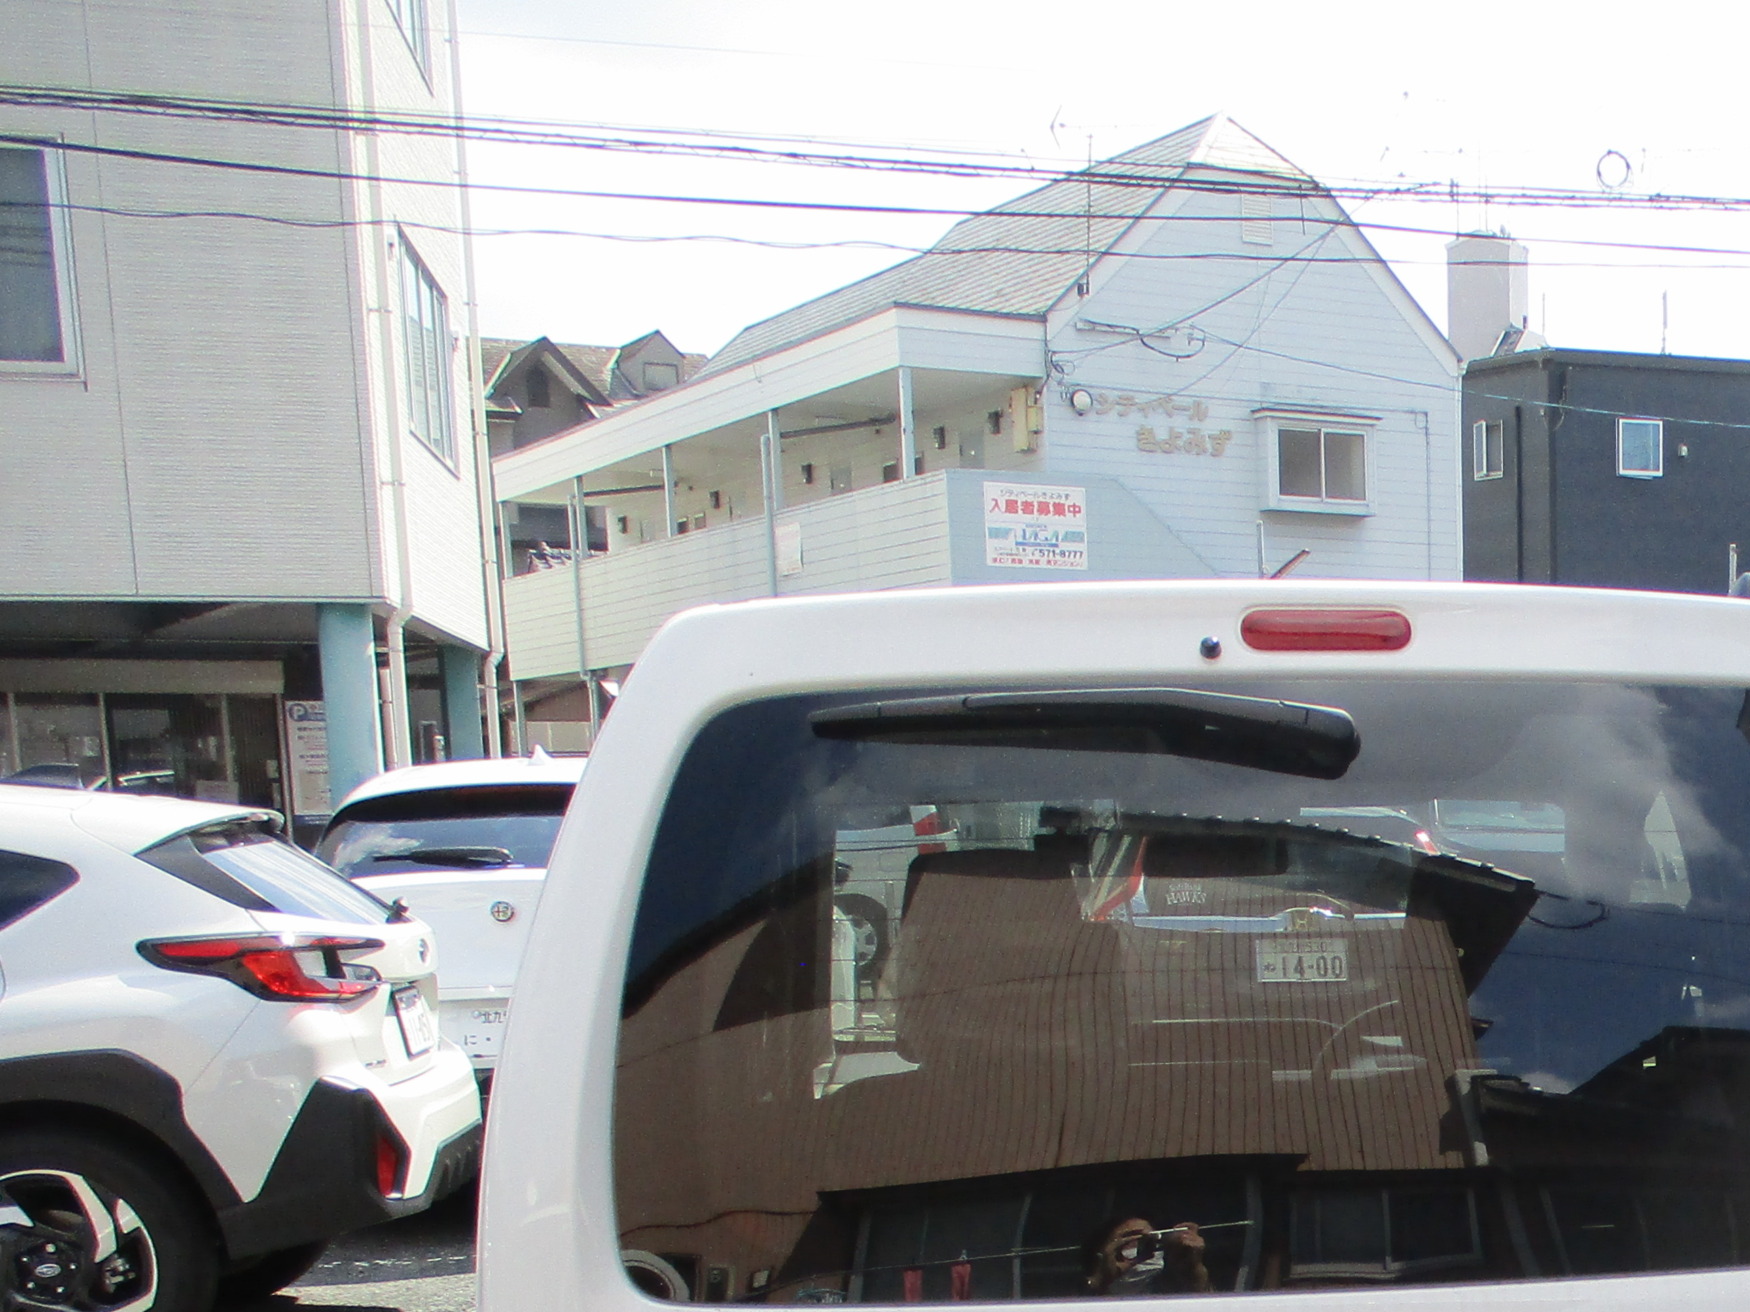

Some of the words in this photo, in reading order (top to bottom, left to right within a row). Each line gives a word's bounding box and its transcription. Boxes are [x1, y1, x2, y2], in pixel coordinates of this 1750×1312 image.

[1136, 424, 1233, 457] きよみず
[989, 497, 1082, 518] 入居者募集中
[1165, 891, 1207, 905] HAWKS
